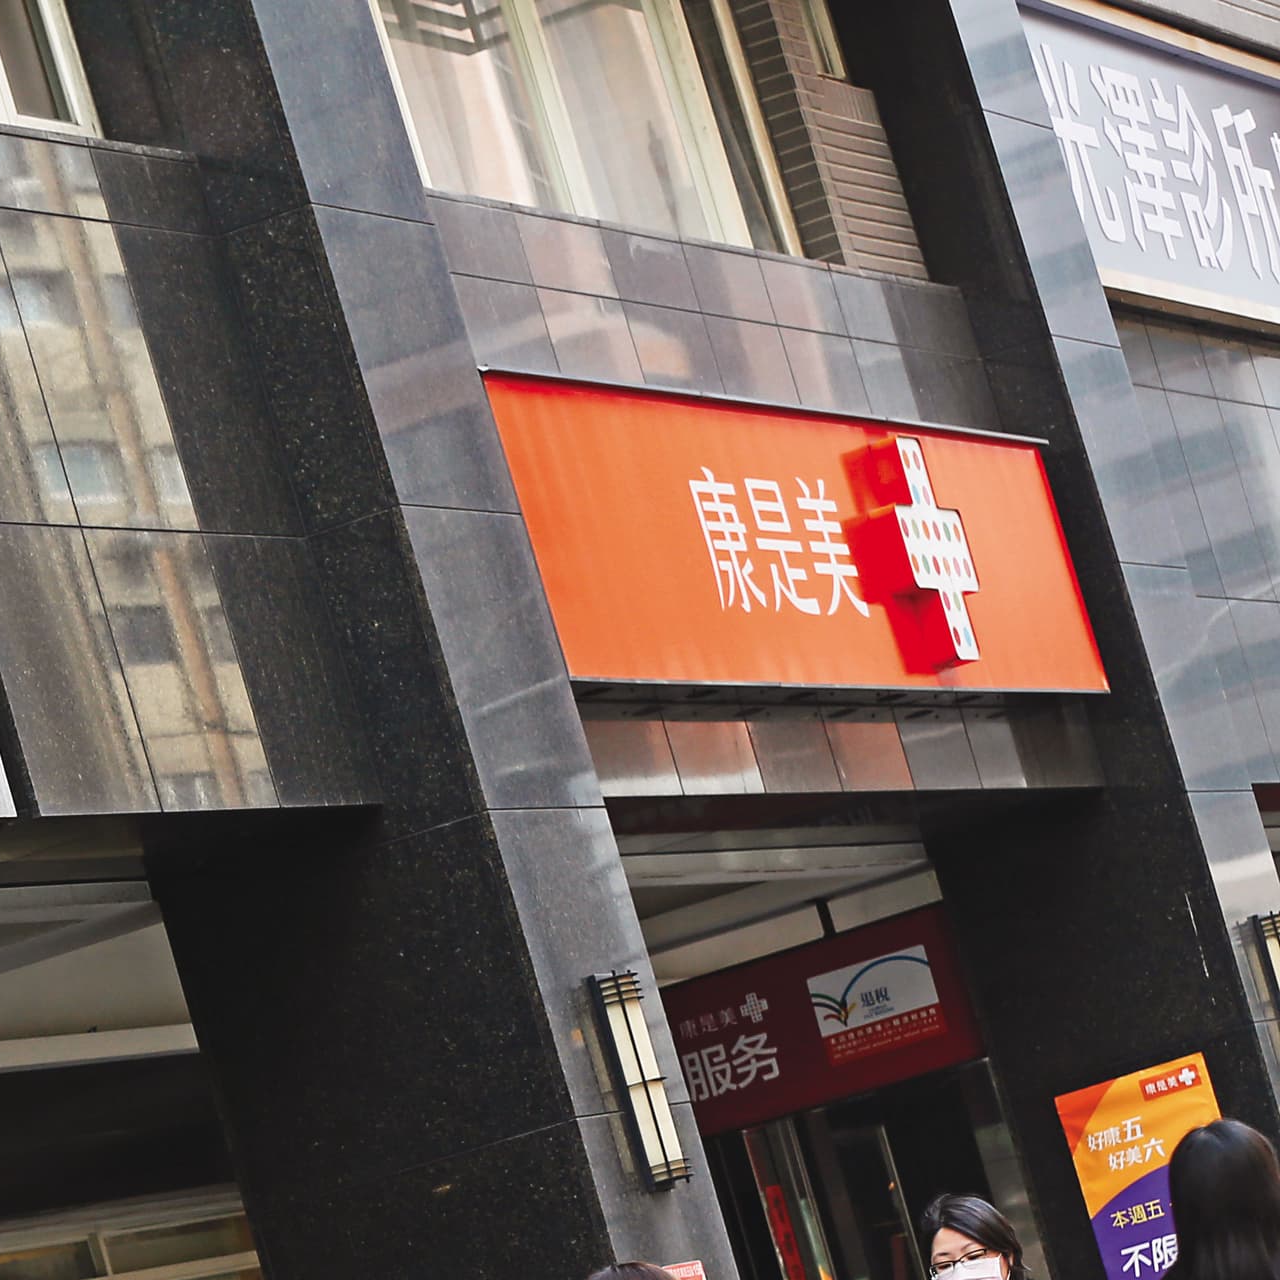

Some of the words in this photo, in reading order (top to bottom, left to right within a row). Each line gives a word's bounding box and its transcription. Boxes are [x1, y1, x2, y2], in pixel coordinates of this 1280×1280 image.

[688, 466, 870, 618] 康是美
[681, 1032, 780, 1102] 服务
[1108, 1137, 1166, 1172] 好美六
